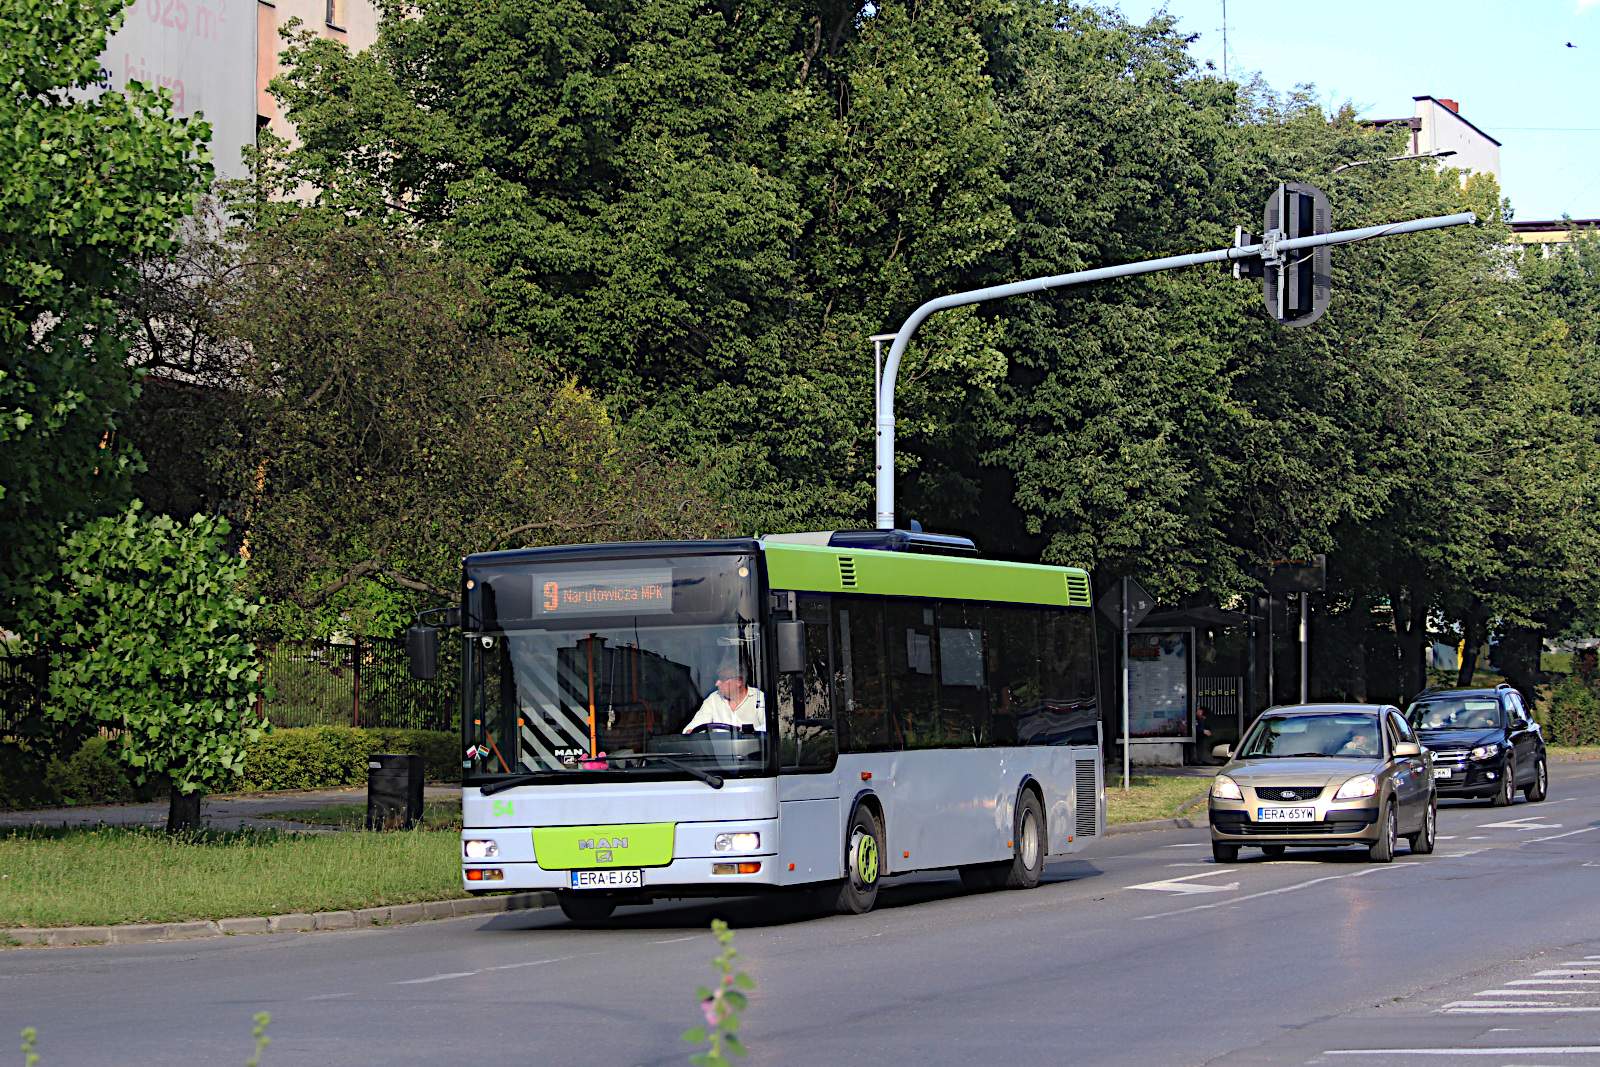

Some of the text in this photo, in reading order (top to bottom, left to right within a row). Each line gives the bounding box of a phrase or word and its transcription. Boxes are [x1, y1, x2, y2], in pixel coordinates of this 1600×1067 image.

[543, 581, 663, 611] 9 Narutowicza MPK
[554, 748, 583, 757] MAN
[493, 800, 515, 817] 54
[1264, 808, 1313, 819] ERA 65YW
[578, 837, 628, 850] MAN
[580, 871, 639, 885] ERA EJ65
